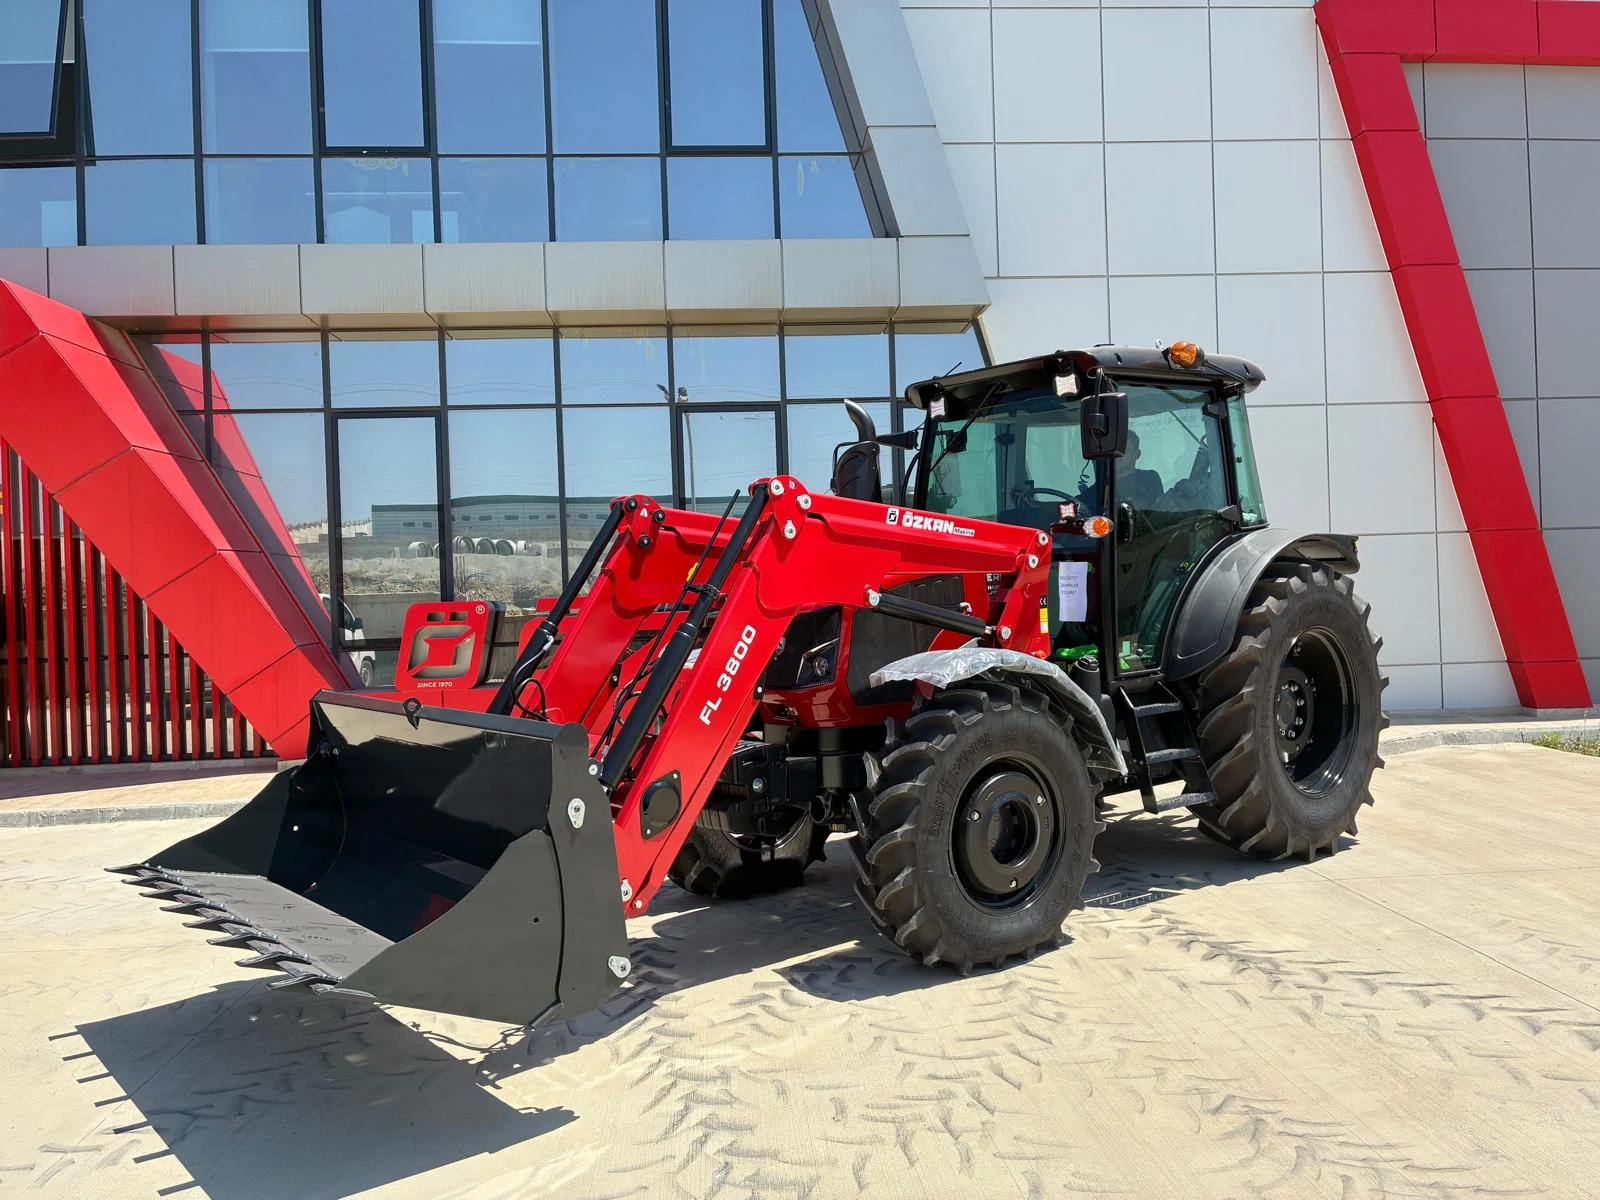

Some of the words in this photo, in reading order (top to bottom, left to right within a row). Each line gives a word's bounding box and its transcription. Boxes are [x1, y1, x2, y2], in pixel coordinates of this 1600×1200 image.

[902, 511, 954, 534] ÖZKAN
[699, 697, 722, 726] FL
[716, 624, 757, 692] 3800
